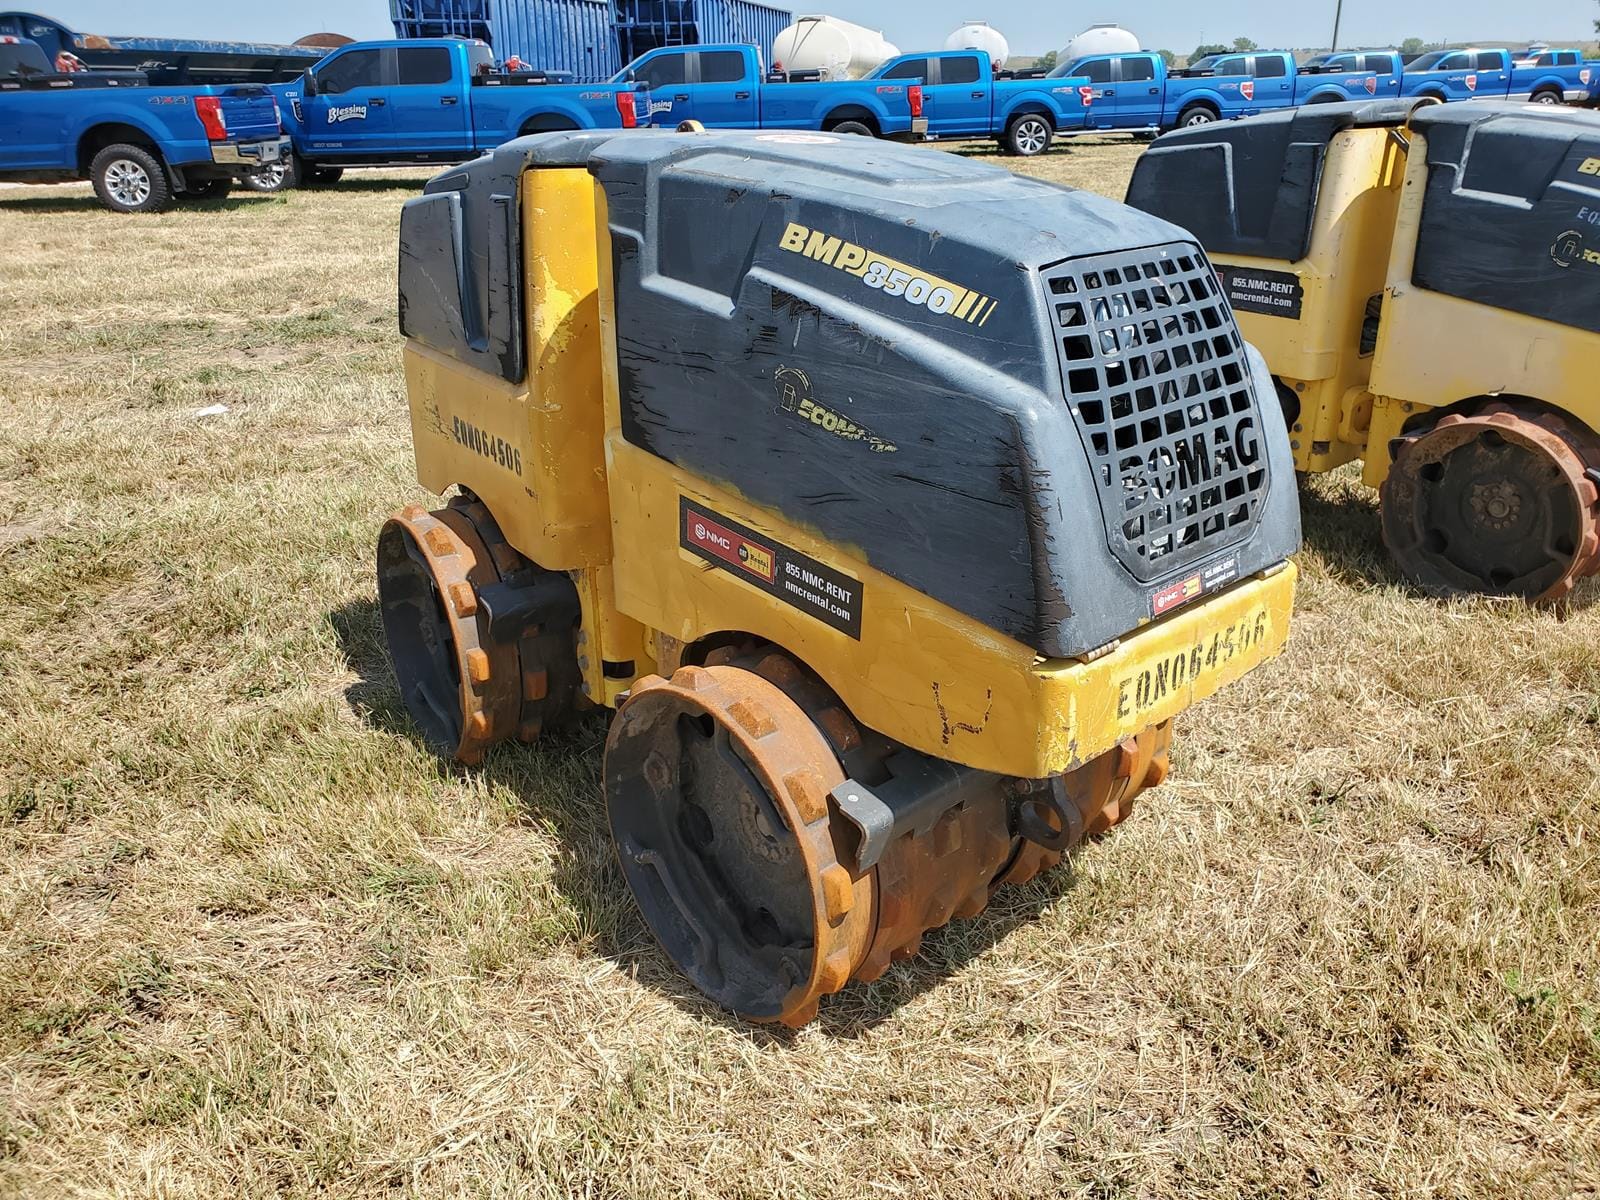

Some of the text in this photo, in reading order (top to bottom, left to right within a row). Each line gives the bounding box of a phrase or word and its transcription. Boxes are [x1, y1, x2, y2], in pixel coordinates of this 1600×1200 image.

[327, 104, 367, 123] Blessing
[779, 222, 955, 315] BMP 8500
[1231, 291, 1292, 307] nmcrental.com
[1232, 277, 1294, 294] 855.NMC.RENT
[1119, 417, 1259, 511] BOMAG
[706, 530, 730, 550] NMC
[785, 561, 852, 604] 855.NMC.RENT
[785, 580, 851, 621] nmcrental.com
